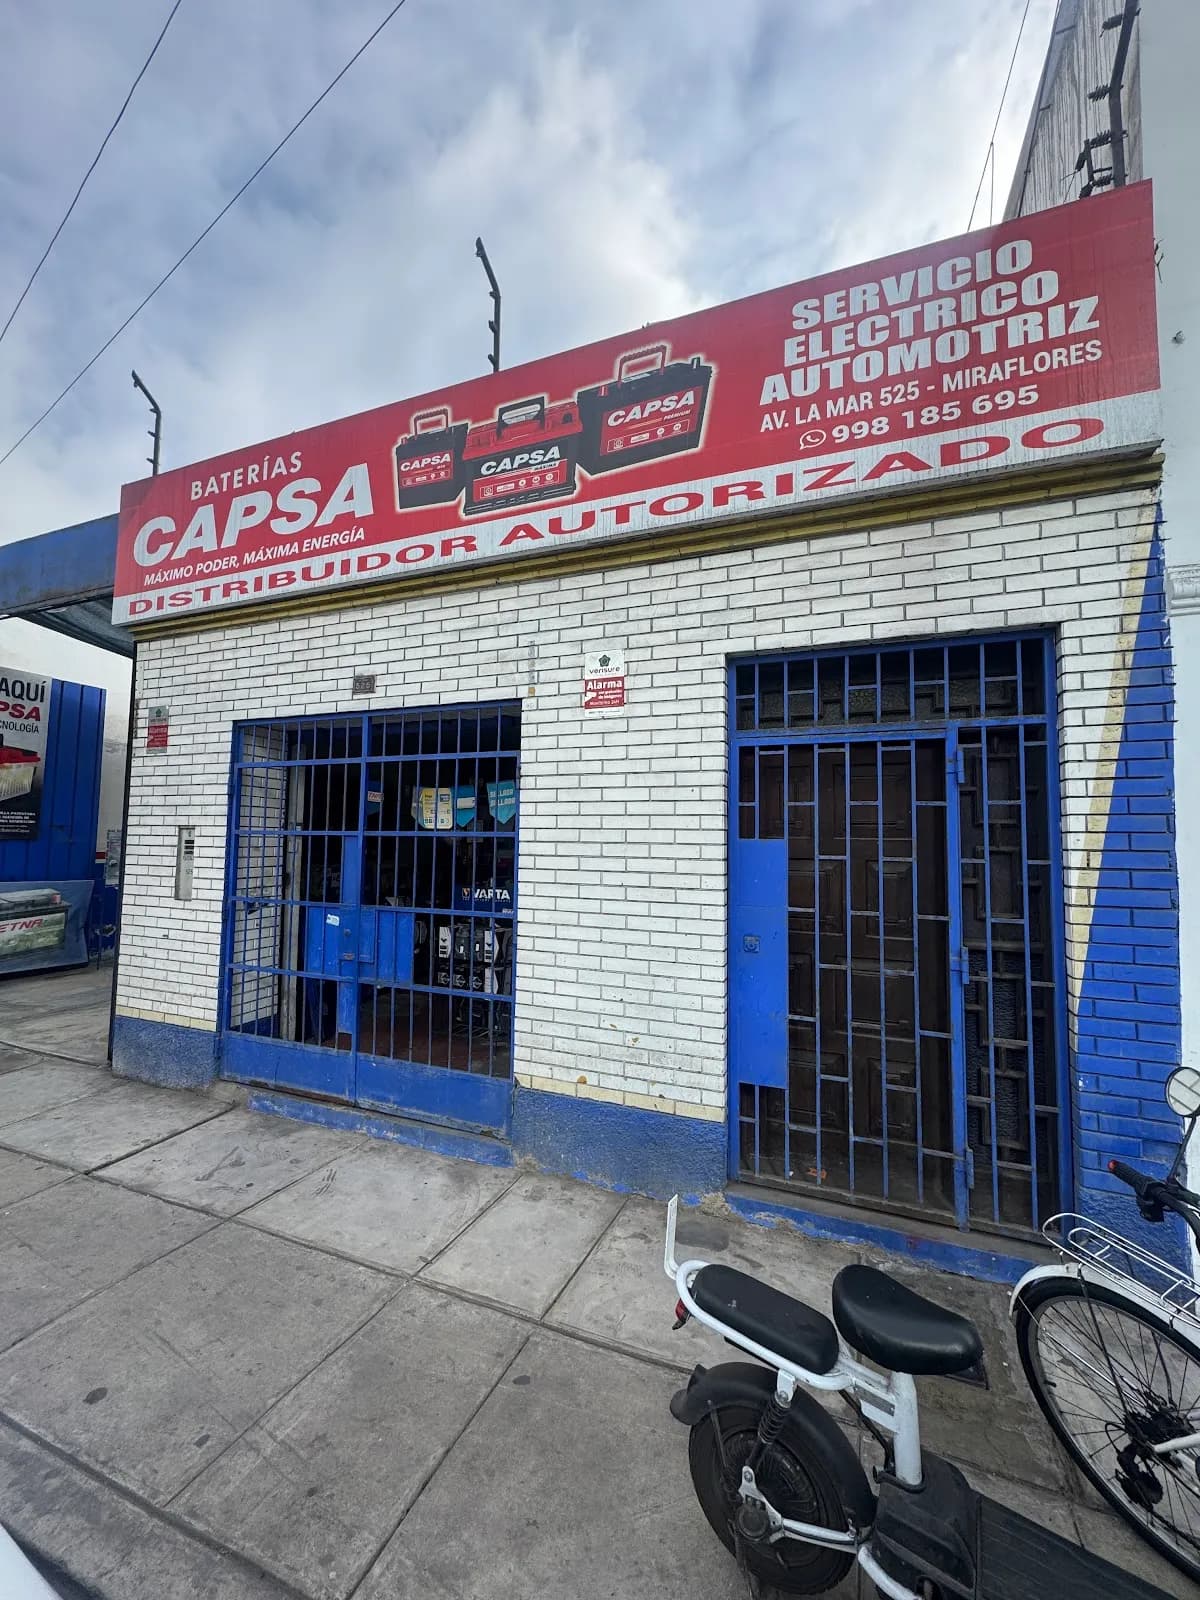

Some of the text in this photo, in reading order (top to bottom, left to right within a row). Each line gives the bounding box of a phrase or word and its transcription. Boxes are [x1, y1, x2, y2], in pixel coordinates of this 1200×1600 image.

[792, 239, 1033, 331] SERVICIO
[784, 271, 1059, 368] ELECTRICO
[759, 296, 1100, 405] AUTOMOTRIZ
[607, 390, 695, 427] CAPSA
[760, 410, 789, 432] AV.
[795, 402, 821, 425] LA
[826, 391, 873, 419] MAR
[880, 381, 920, 408] 525
[943, 339, 1102, 393] MIRAFLORES
[832, 384, 1039, 443] 998 185 695
[190, 451, 303, 500] BATERÍAS
[400, 453, 451, 471] CAPSA
[480, 446, 561, 476] CAPSA
[128, 417, 1105, 616] DISTRIBUIDOR AUTORIZADO
[132, 462, 375, 567] CAPSA
[144, 526, 365, 586] MÁXIMO PODER, MÁXIMA ENERGÍA
[0, 677, 47, 702] AQUÍ
[587, 680, 623, 690] Alarma
[590, 666, 621, 674] verisure
[472, 888, 510, 900] VARTA
